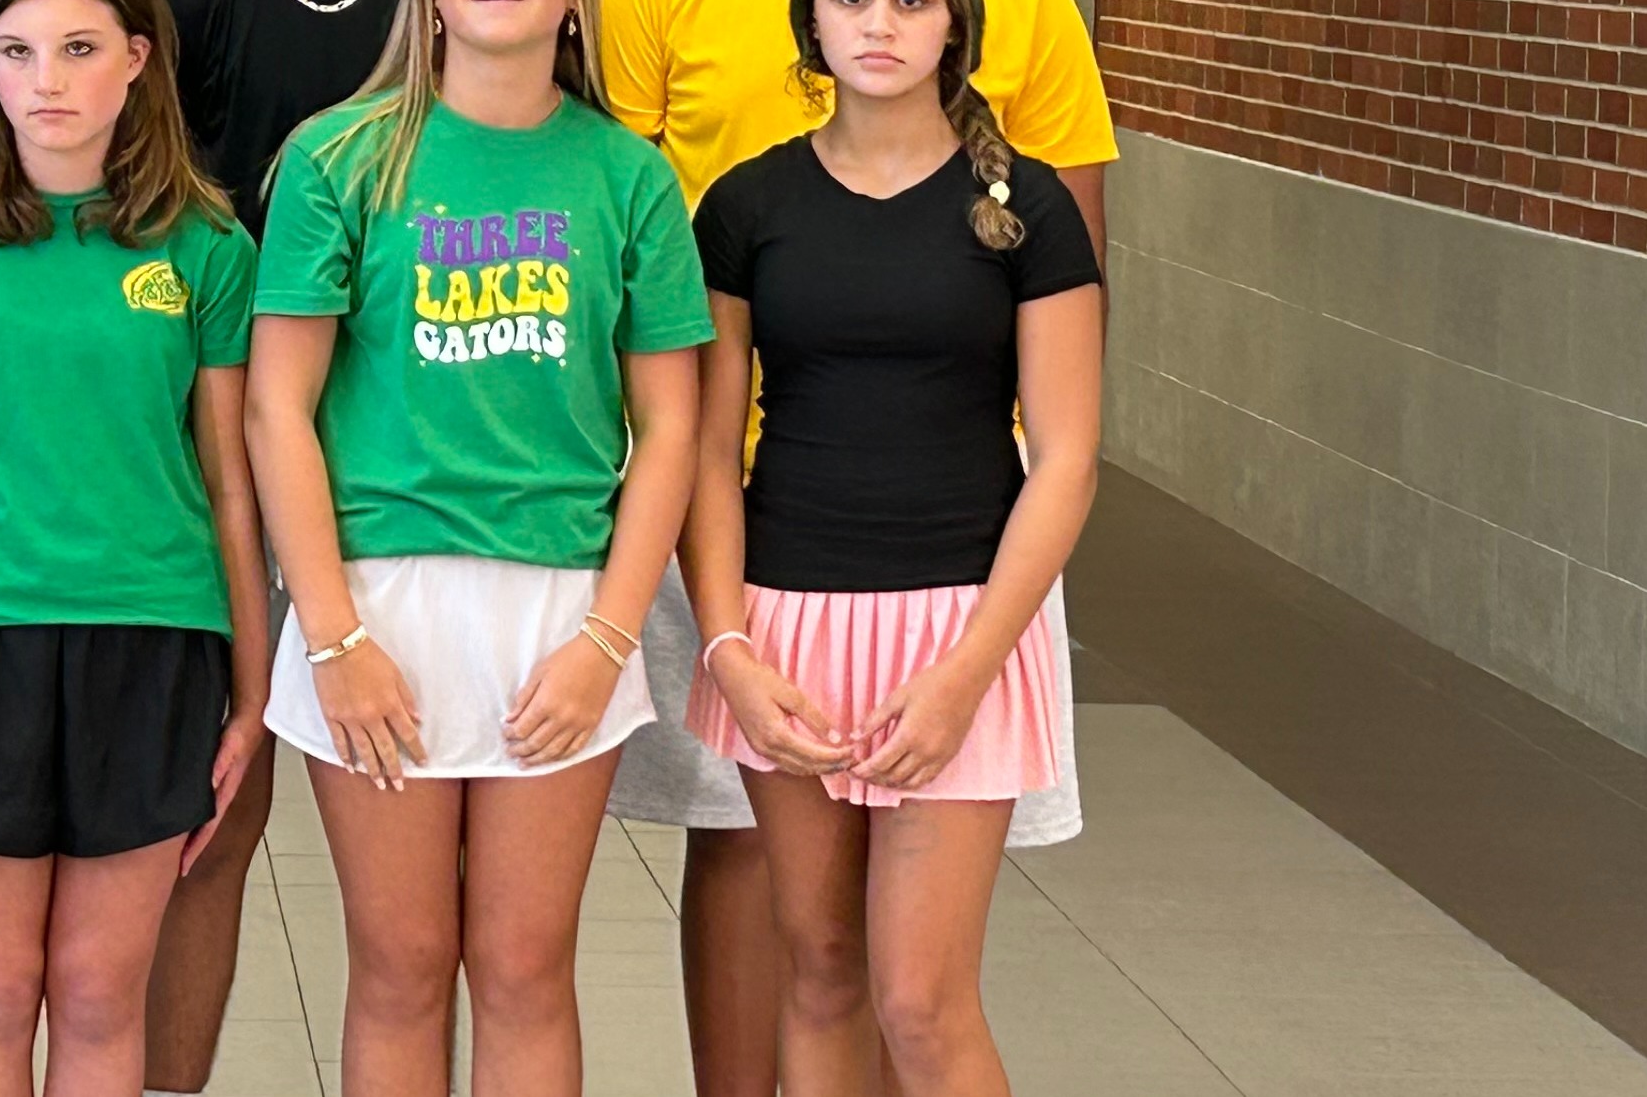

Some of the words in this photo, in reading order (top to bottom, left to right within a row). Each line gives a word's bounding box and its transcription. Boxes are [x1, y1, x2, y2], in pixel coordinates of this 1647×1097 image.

[416, 210, 569, 266] THREE
[414, 260, 570, 322] LAKES
[413, 315, 567, 363] GATORS
